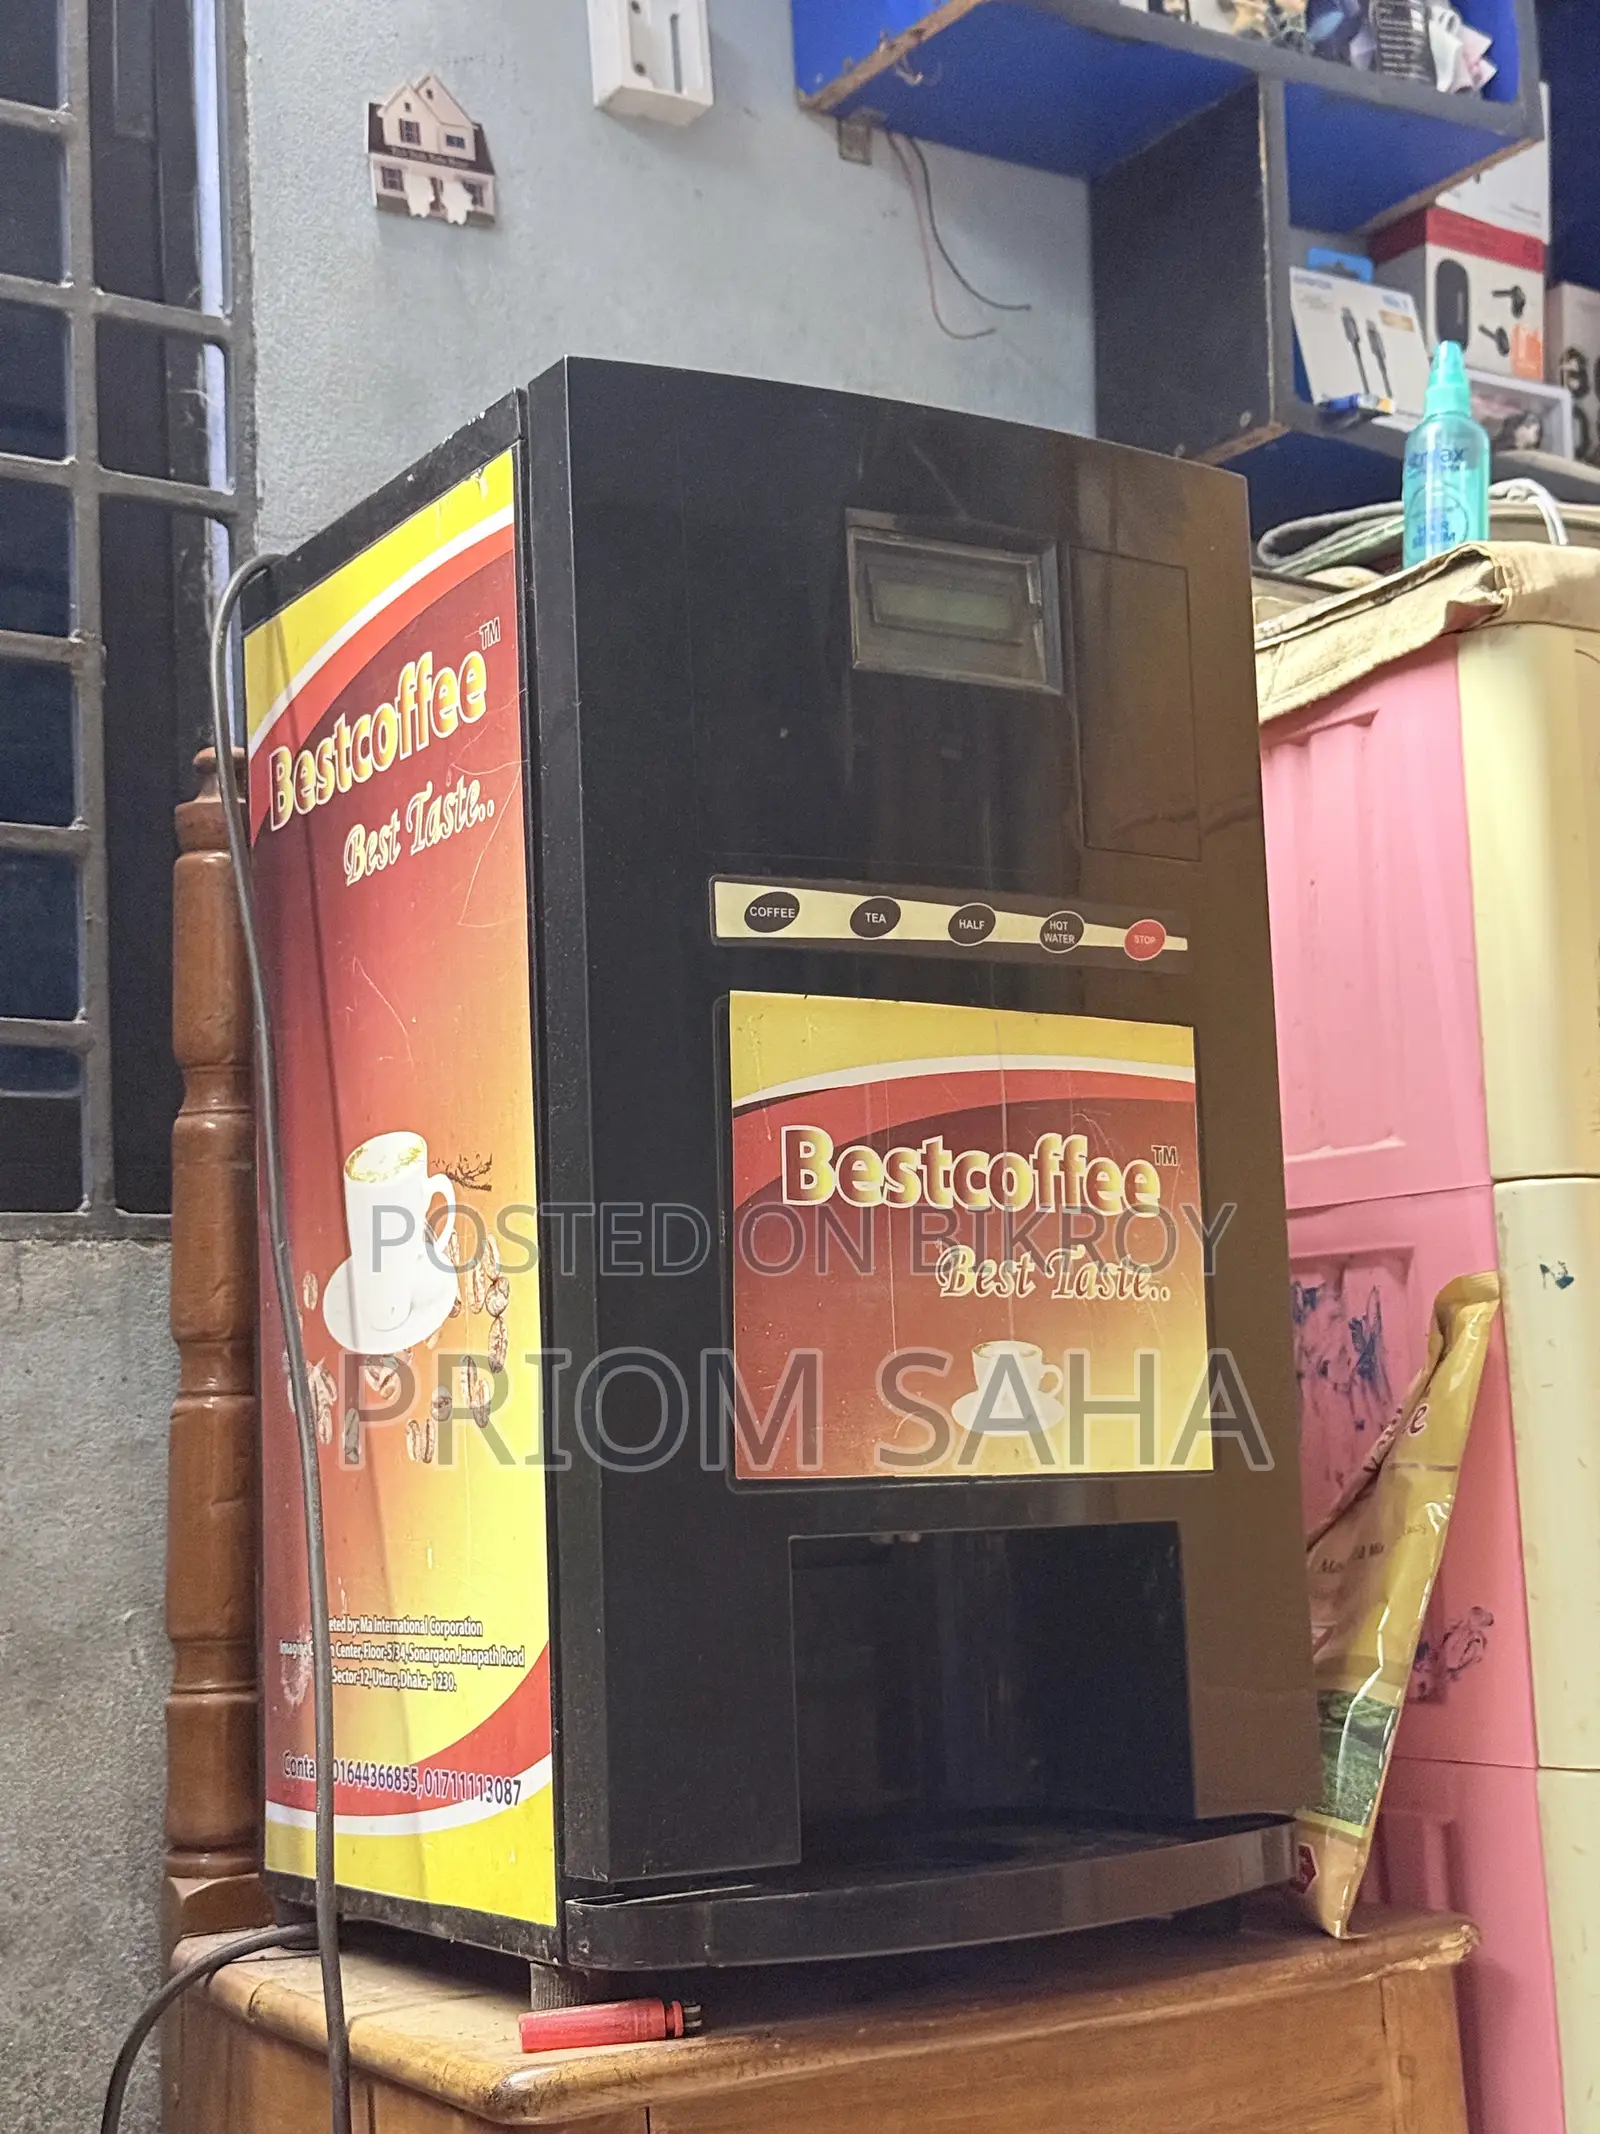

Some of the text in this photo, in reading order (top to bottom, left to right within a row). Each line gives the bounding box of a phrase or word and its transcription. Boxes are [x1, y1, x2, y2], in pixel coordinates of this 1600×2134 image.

[269, 650, 488, 832] Bestcoffee
[343, 808, 402, 886] Best
[749, 904, 796, 920] COFFEE
[864, 911, 887, 925] TEA
[958, 918, 985, 931] HALF
[1048, 919, 1069, 932] HOT
[1043, 932, 1076, 946] WATER
[1133, 933, 1157, 945] STOP
[781, 1124, 1162, 1218] Bestcoffee
[936, 1244, 1035, 1299] Best
[347, 1614, 359, 1638] by:
[360, 1615, 373, 1633] Ma
[374, 1615, 428, 1636] International
[429, 1616, 483, 1640] Corporation
[408, 1642, 456, 1668] Sonargaon
[457, 1644, 499, 1670] Janapath
[500, 1645, 525, 1667] Road
[282, 1750, 317, 1781] Conta
